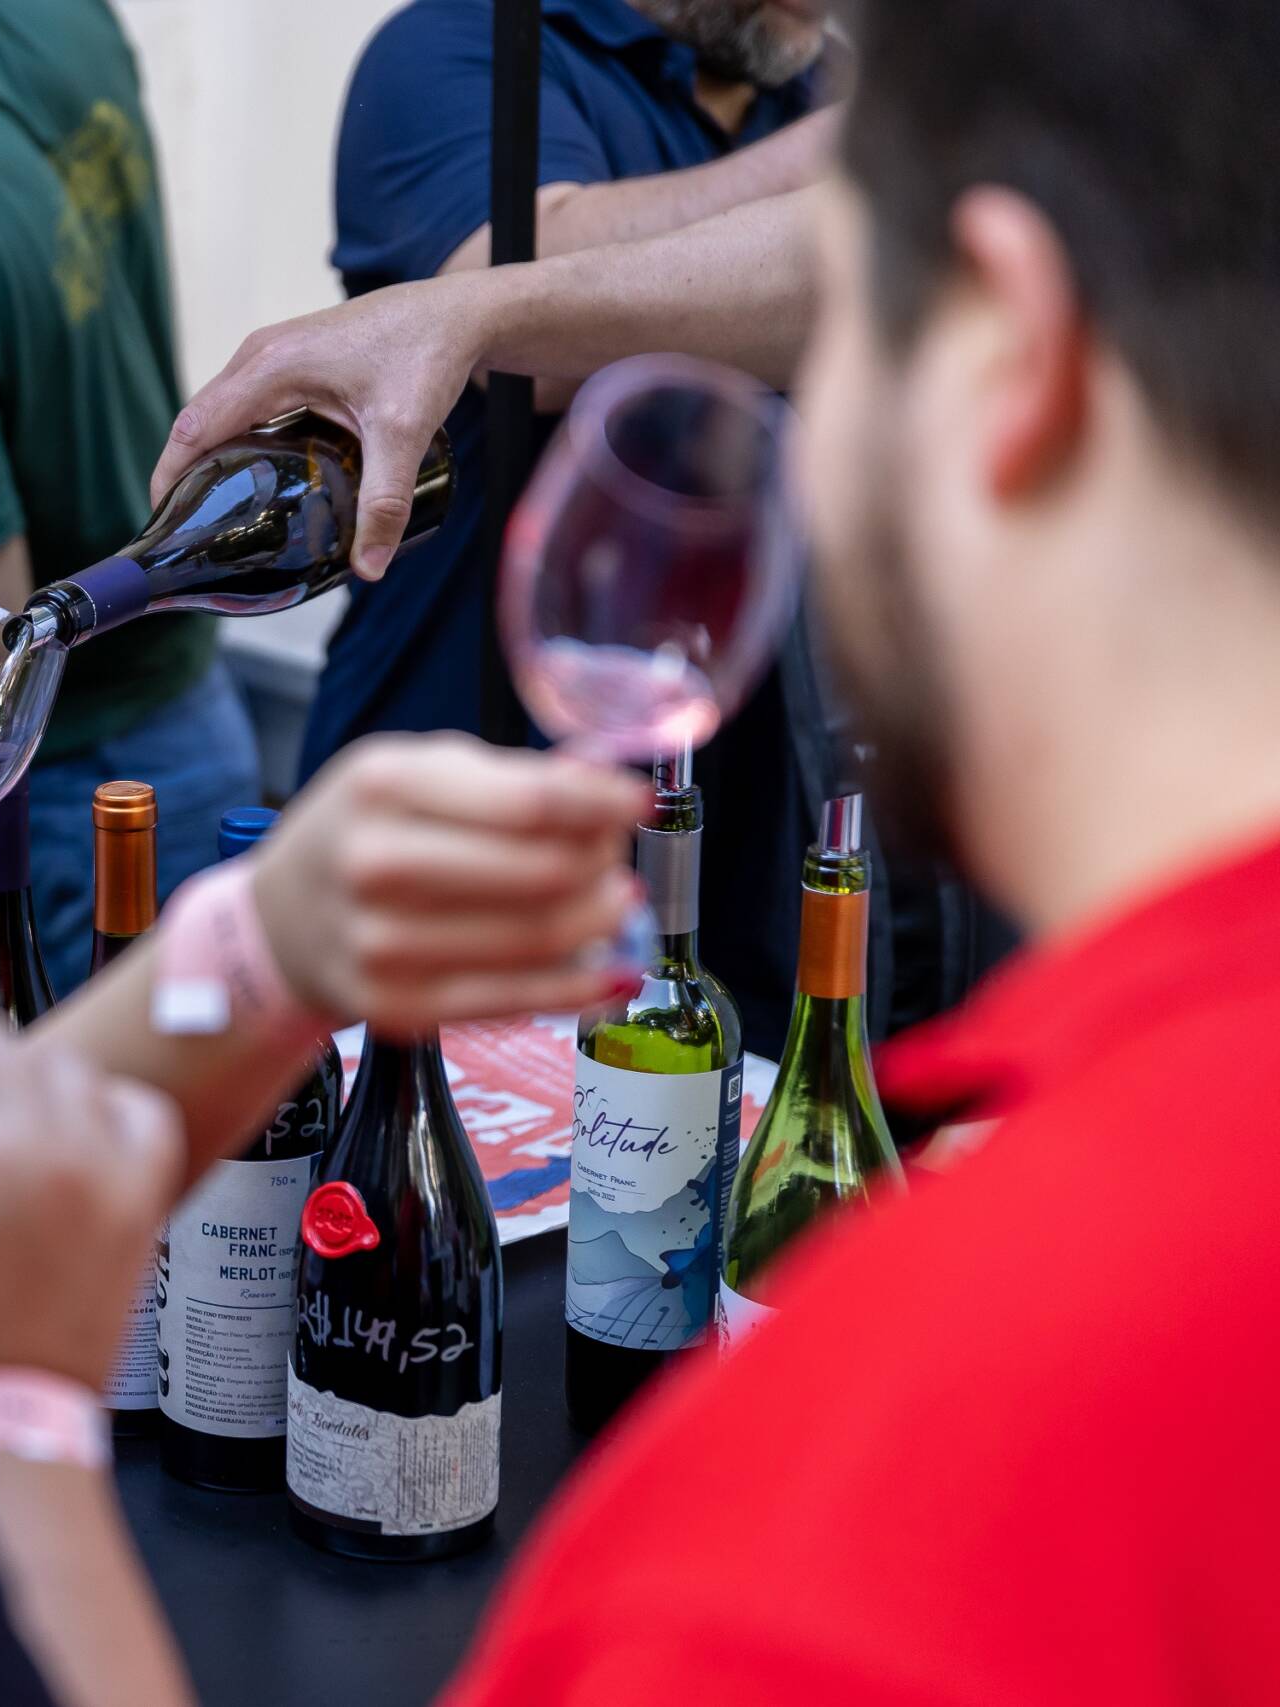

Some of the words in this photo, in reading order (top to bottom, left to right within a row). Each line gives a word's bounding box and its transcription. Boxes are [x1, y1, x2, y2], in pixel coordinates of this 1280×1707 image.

[572, 1112, 678, 1162] Solitude
[270, 1177, 288, 1187] 750
[610, 1175, 637, 1188] FRANC
[201, 1222, 278, 1241] CABERNET
[229, 1244, 278, 1258] FRANC
[220, 1265, 277, 1280] MERLOT
